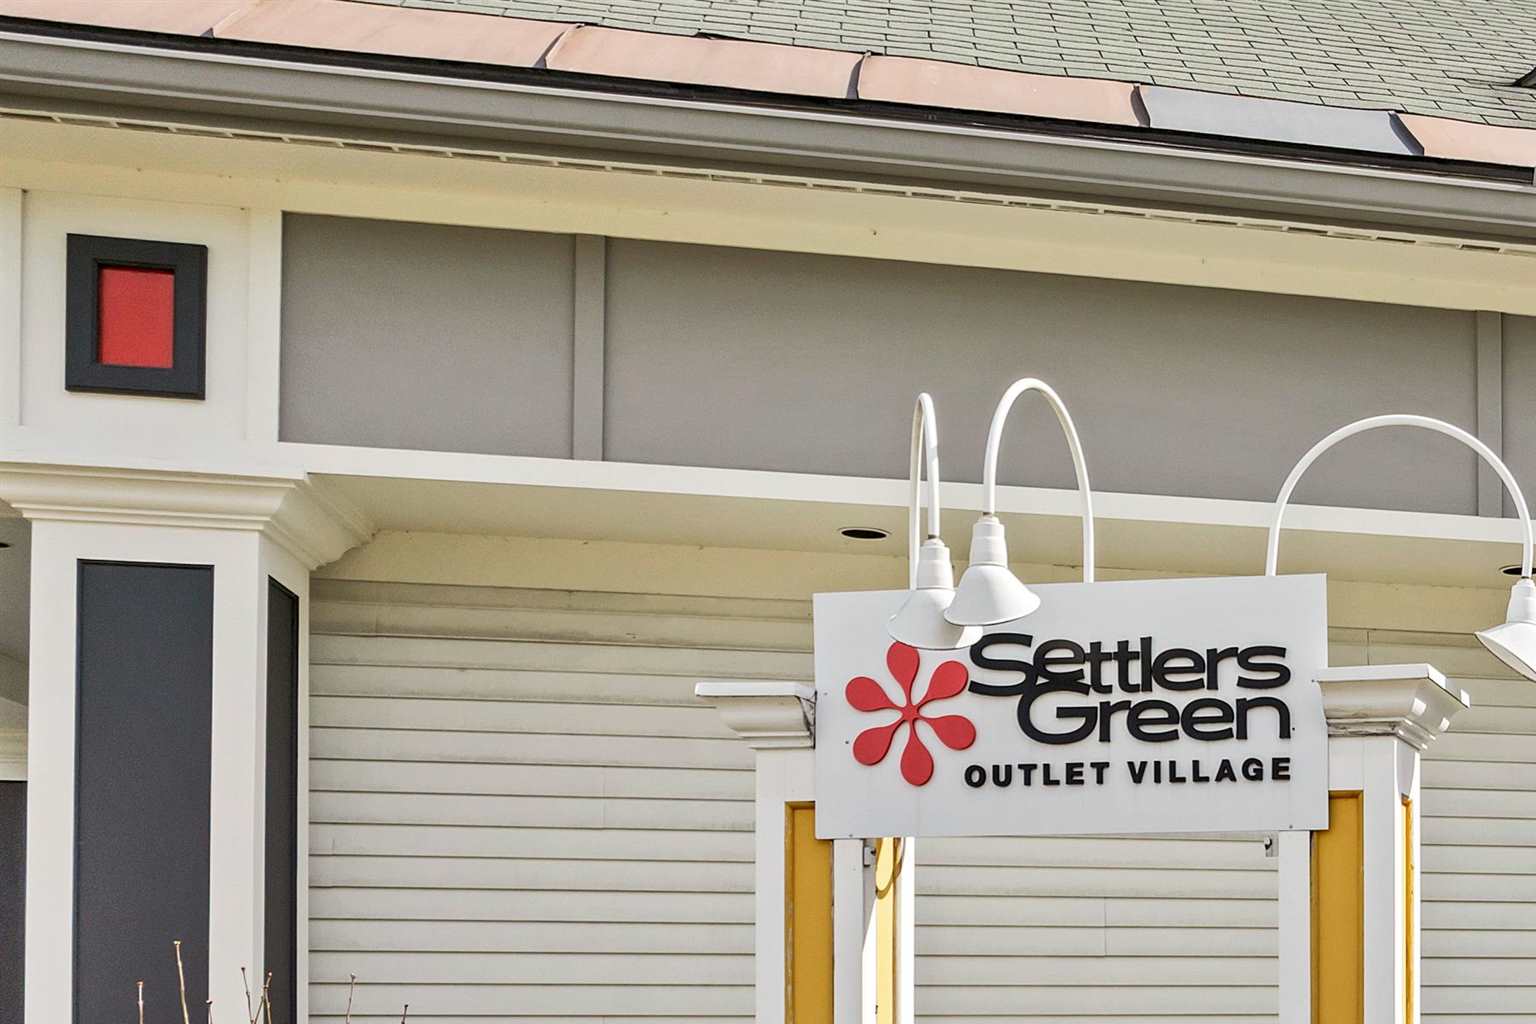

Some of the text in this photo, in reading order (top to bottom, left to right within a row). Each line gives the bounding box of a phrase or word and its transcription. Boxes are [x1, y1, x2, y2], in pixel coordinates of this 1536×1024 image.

[967, 632, 1291, 697] Settlers
[1016, 682, 1291, 745] Green
[964, 757, 1291, 789] OUTLET VILLAGE
